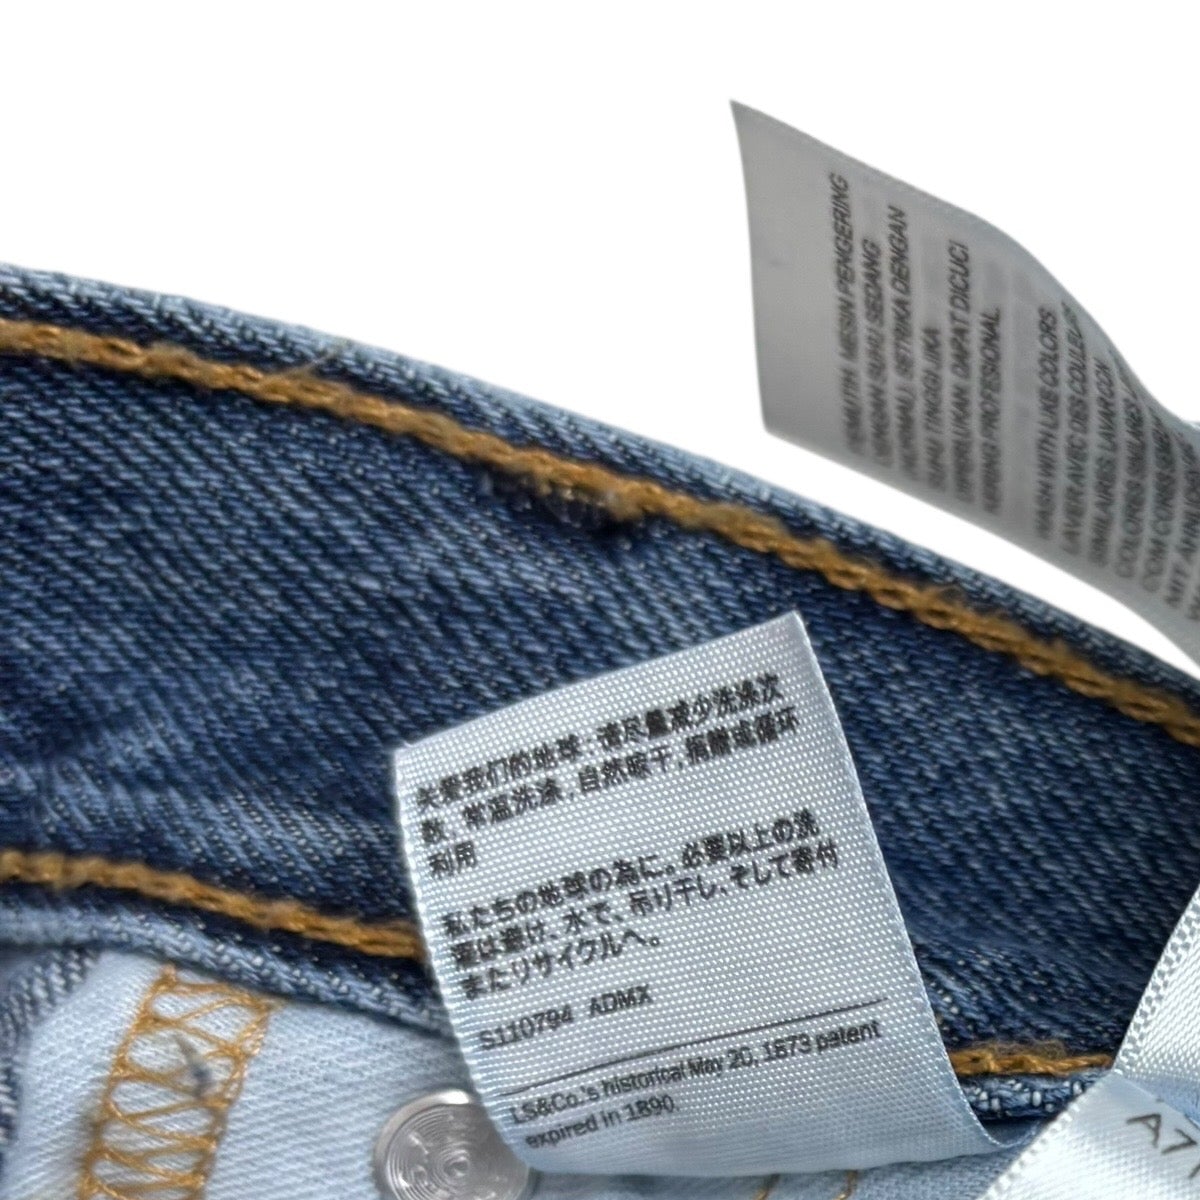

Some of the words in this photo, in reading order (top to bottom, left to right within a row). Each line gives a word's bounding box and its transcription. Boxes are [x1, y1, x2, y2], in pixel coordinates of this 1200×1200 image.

[829, 171, 854, 294] PENGERING
[888, 204, 909, 294] DENGAN
[862, 239, 883, 327] SEDANG
[948, 239, 967, 311] DICUCI
[837, 296, 858, 360] MESIN
[863, 330, 886, 379] SUHU
[891, 299, 915, 380] SETRIKA
[922, 327, 940, 371] JIKA
[949, 313, 969, 379] DAPAT
[1037, 307, 1056, 386] COLORS
[923, 374, 942, 435] TINGGI
[1093, 358, 1113, 397] CON
[1038, 390, 1056, 429] LIKE
[1065, 397, 1086, 432] DES
[1097, 398, 1115, 452] LAVAR
[1038, 431, 1056, 475] WITH
[1065, 436, 1086, 483] AVEC
[1037, 480, 1056, 537] WASH
[1063, 484, 1083, 553] LAVER
[428, 841, 477, 880] 利用
[478, 1002, 574, 1050] S110794
[588, 984, 653, 1018] ADMX
[510, 1081, 597, 1124] LS&Co.'s
[599, 1058, 686, 1101] historical
[689, 1049, 724, 1081] May
[764, 1032, 812, 1065] 1873
[815, 1018, 882, 1058] patent
[525, 1114, 598, 1150] expired
[600, 1107, 621, 1128] in
